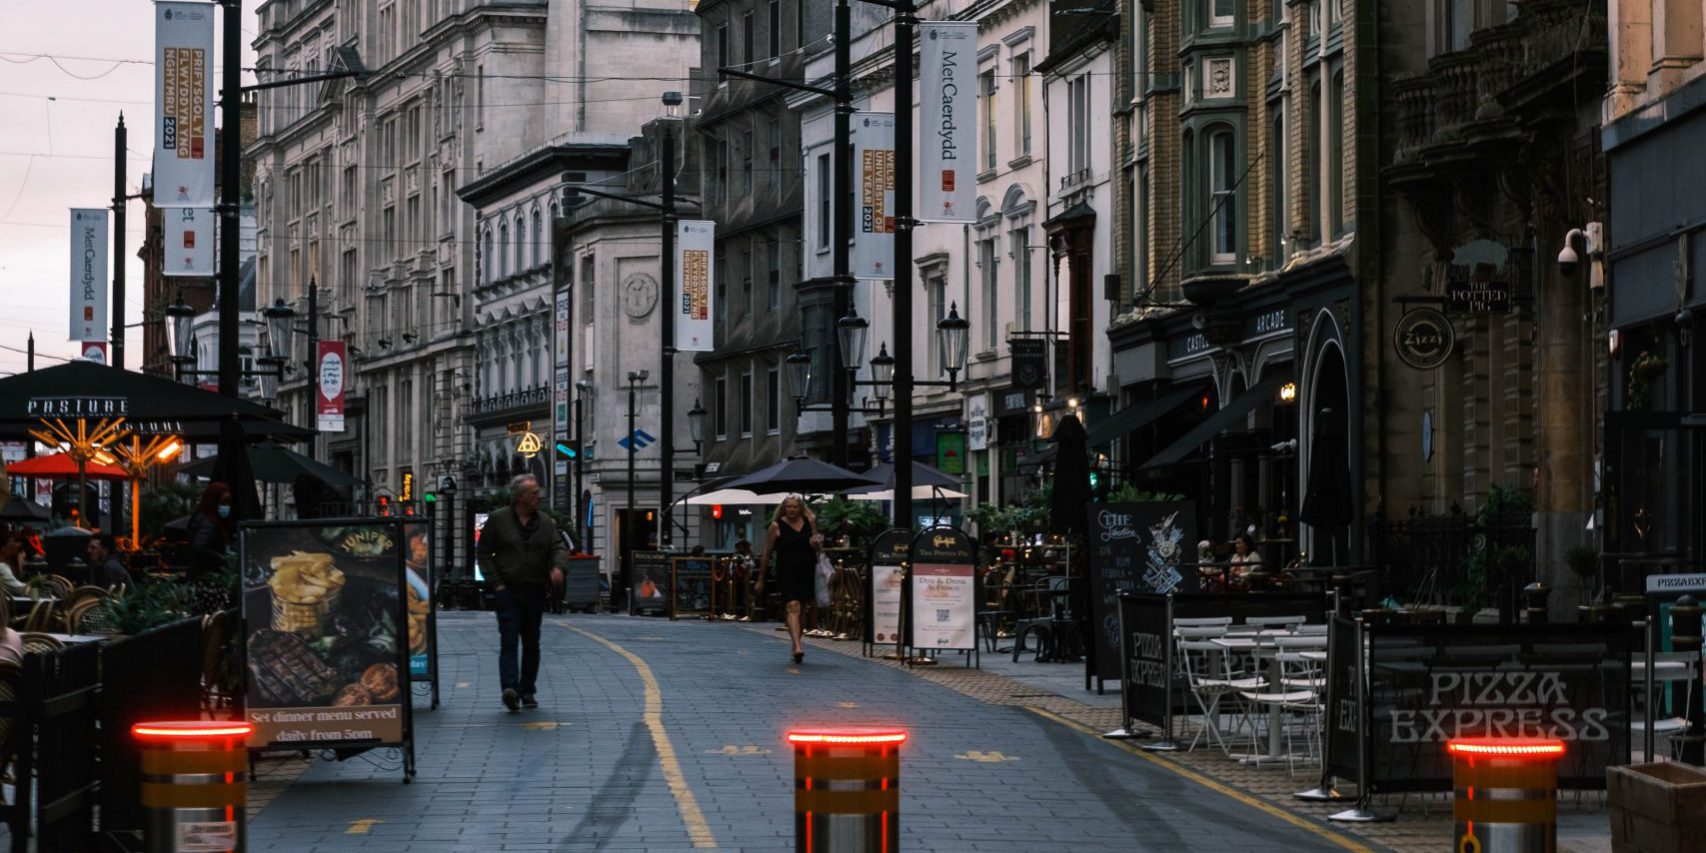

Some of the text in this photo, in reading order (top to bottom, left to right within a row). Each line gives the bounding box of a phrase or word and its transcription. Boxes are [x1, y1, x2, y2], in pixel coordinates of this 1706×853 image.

[165, 49, 175, 148] NGHYMRU 2021
[192, 49, 203, 122] PRIFYSGOL
[178, 49, 189, 157] FLWYDDYN YNG
[938, 51, 957, 160] MetCaerdydd
[886, 151, 894, 189] WELSH
[864, 151, 872, 232] THE YEAR 2021
[875, 151, 883, 232] UNIVERSITY OF
[82, 227, 95, 300] MetCaerdydd
[1451, 290, 1507, 301] POTTED
[1470, 301, 1491, 312] PIG
[1257, 310, 1285, 333] ARCADE
[1404, 332, 1443, 346] Zizzi
[28, 399, 128, 413] PASTURE
[1133, 632, 1162, 659] PIZZA
[1429, 671, 1569, 705] PIZZA
[251, 708, 397, 723] Set dinner menu served
[1389, 707, 1609, 742] EXPRESS
[276, 729, 373, 741] daily from 5pm
